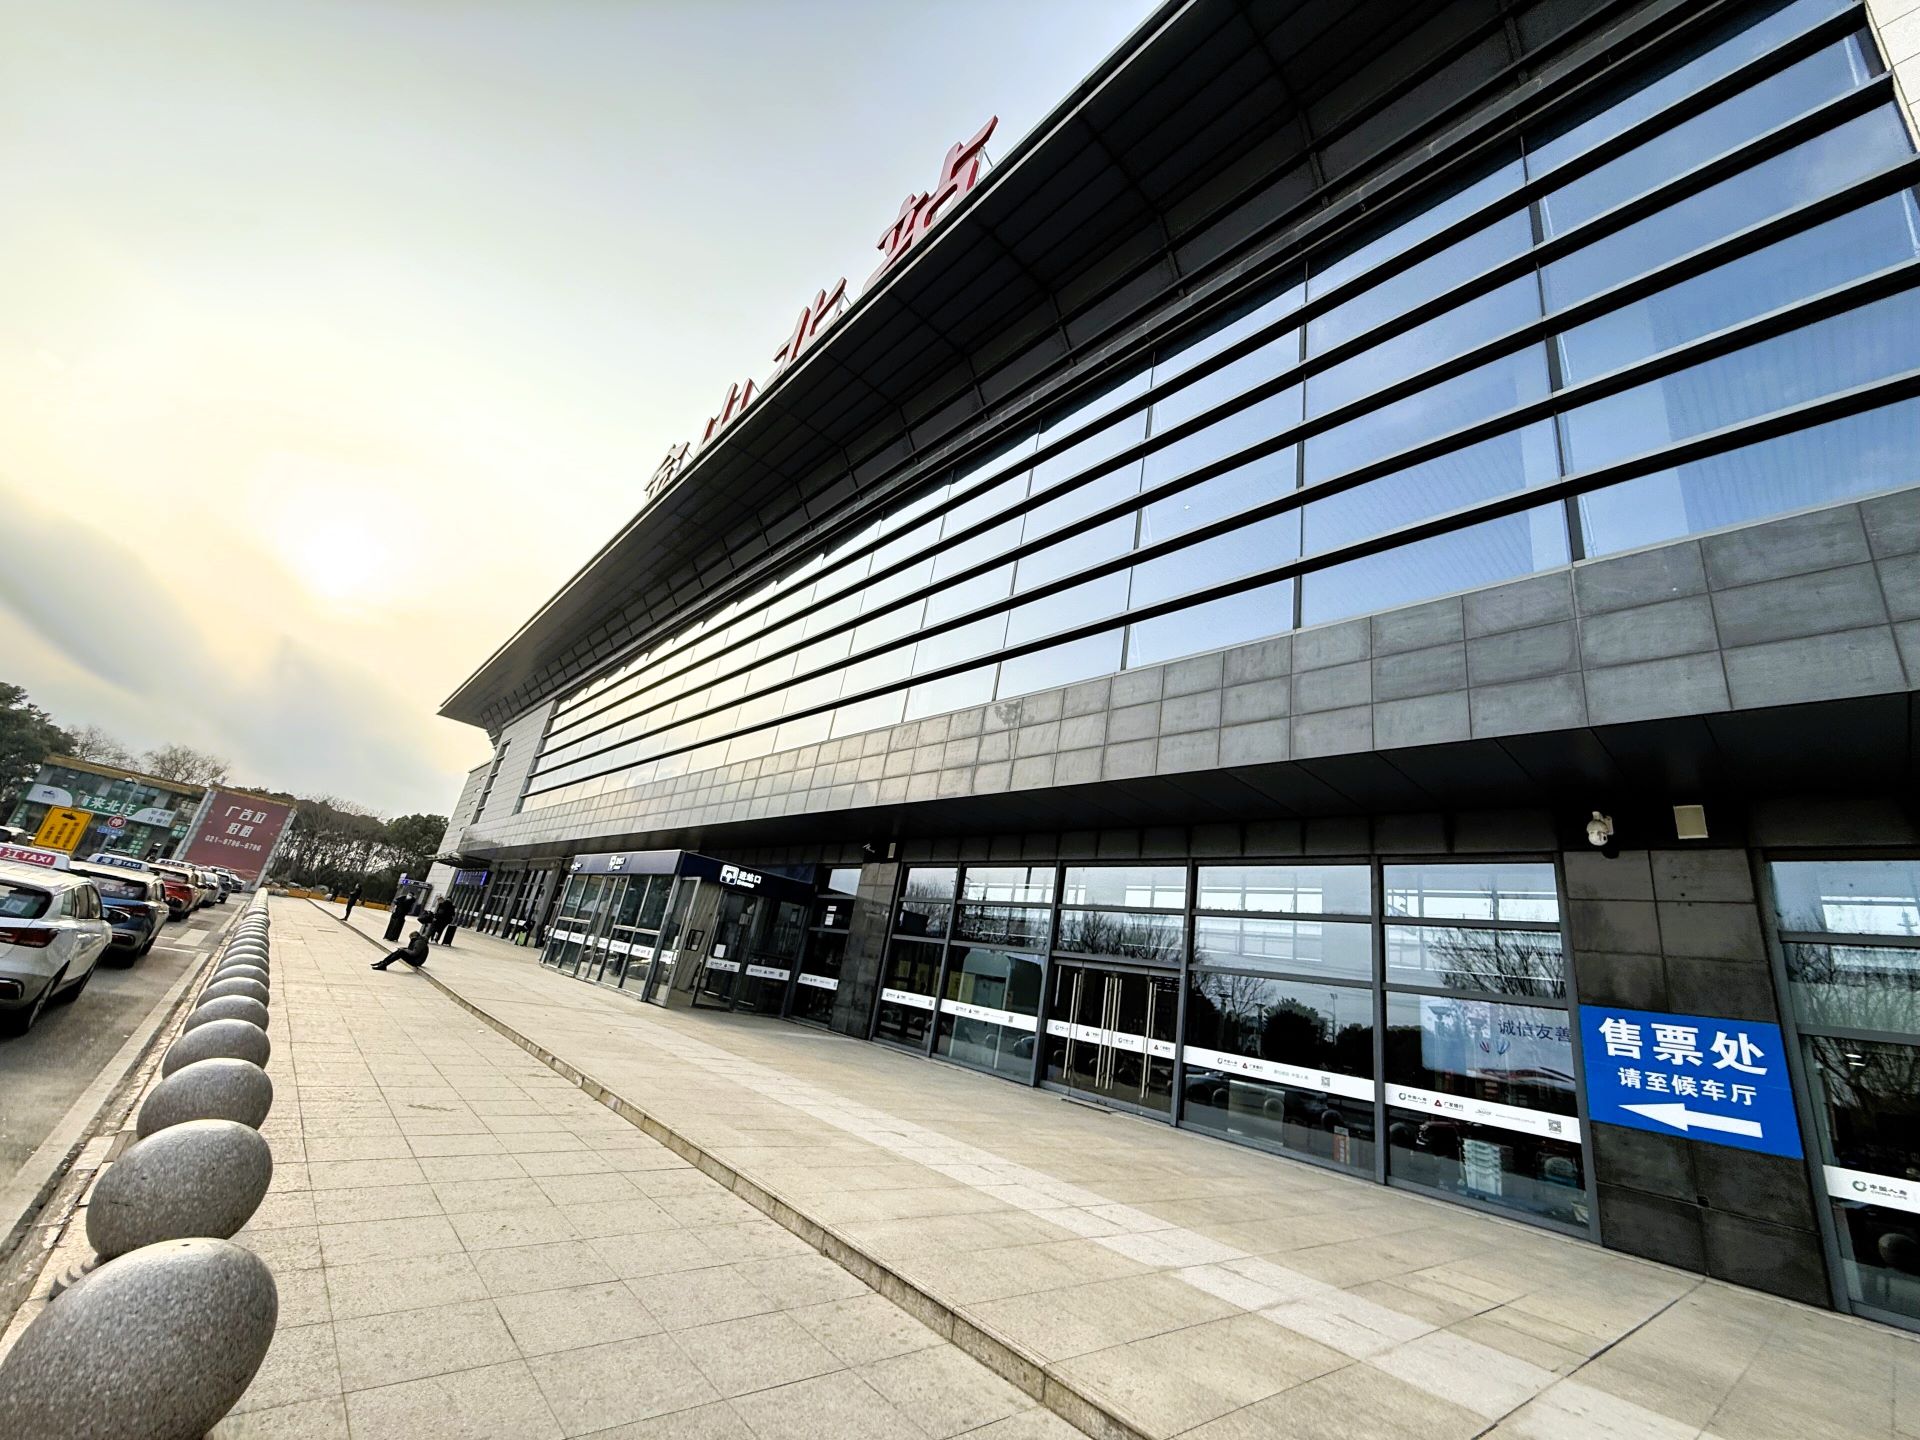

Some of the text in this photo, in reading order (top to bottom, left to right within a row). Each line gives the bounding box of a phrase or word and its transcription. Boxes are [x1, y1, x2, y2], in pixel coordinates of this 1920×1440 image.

[1498, 1019, 1571, 1043] 诚信友善
[1598, 1016, 1768, 1076] 售票处
[1617, 1067, 1757, 1106] 请至候车厅
